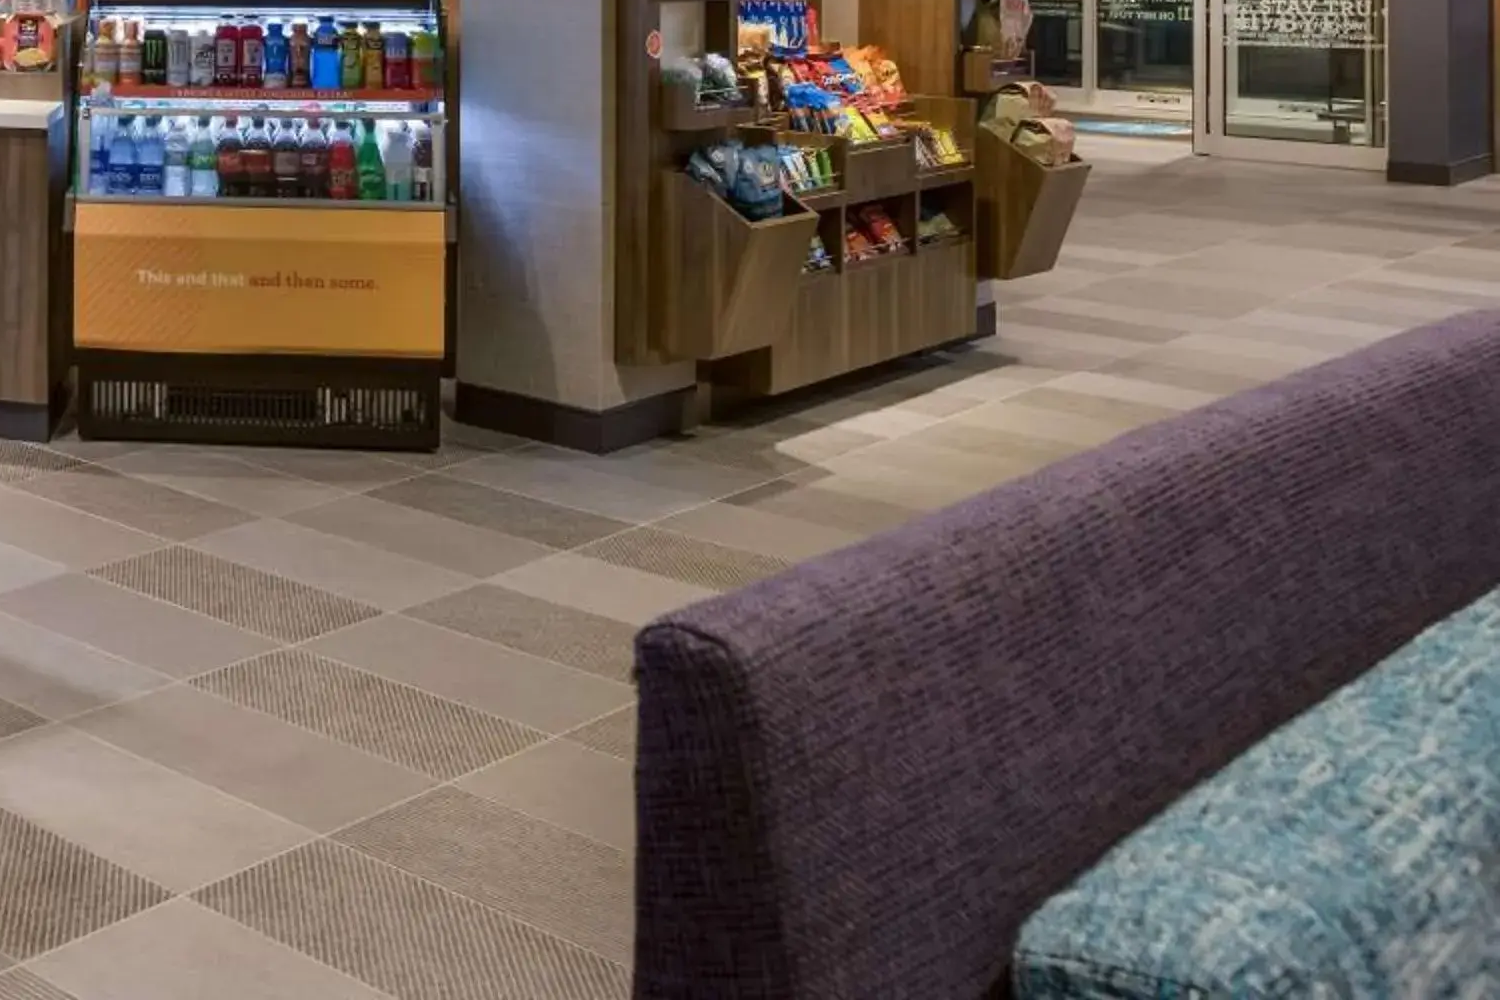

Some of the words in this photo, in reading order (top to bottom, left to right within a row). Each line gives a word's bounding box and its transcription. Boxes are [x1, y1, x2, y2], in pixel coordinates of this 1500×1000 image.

[137, 268, 173, 285] This
[176, 269, 206, 286] and
[211, 270, 245, 287] that
[249, 271, 282, 288] and
[286, 271, 325, 289] then
[329, 278, 380, 291] some.
